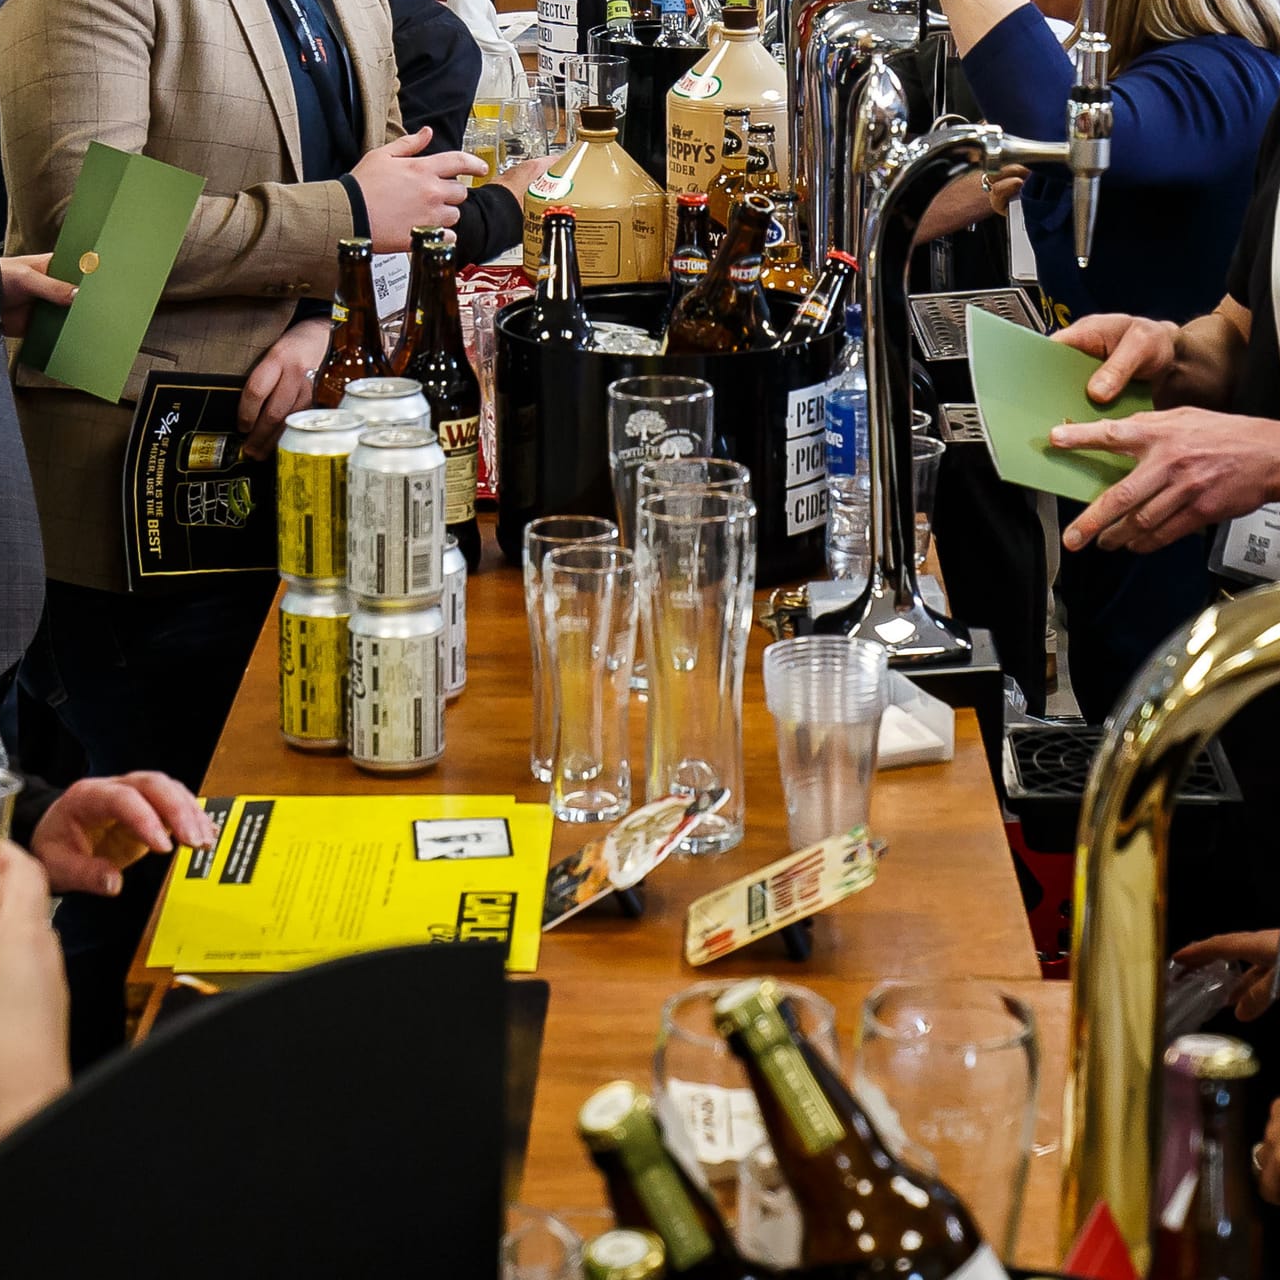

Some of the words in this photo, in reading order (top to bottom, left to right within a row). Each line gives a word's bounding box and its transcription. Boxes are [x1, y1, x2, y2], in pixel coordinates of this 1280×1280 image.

[672, 259, 709, 271] WESTONS
[154, 412, 179, 440] 3/4
[156, 458, 166, 486] DRINK
[146, 478, 155, 496] USE
[155, 489, 163, 499] IS
[146, 500, 155, 516] THE
[155, 501, 164, 517] THE
[352, 640, 366, 700] Cider
